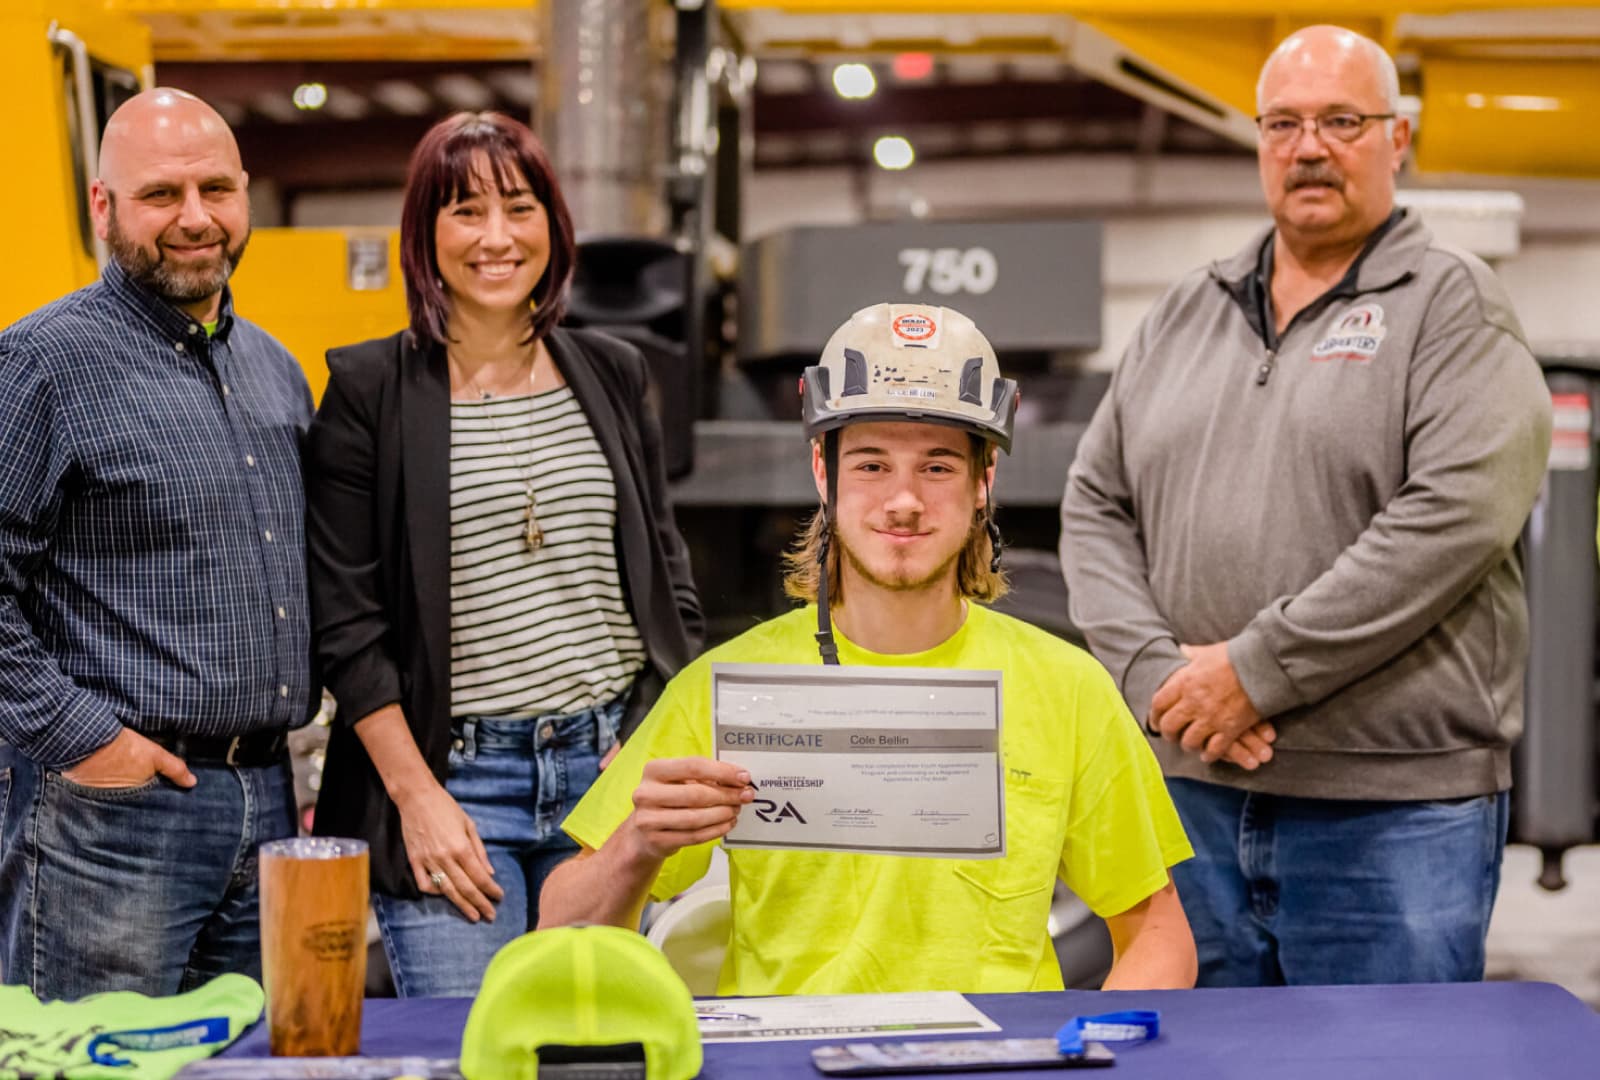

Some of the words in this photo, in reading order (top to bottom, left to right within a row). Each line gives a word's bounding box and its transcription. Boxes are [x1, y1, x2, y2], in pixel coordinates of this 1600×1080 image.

[898, 248, 997, 294] 750
[724, 731, 824, 748] CERTIFICATE
[850, 735, 875, 746] Cole
[879, 736, 909, 746] Bellin
[760, 779, 824, 788] APPRENTICESHIP
